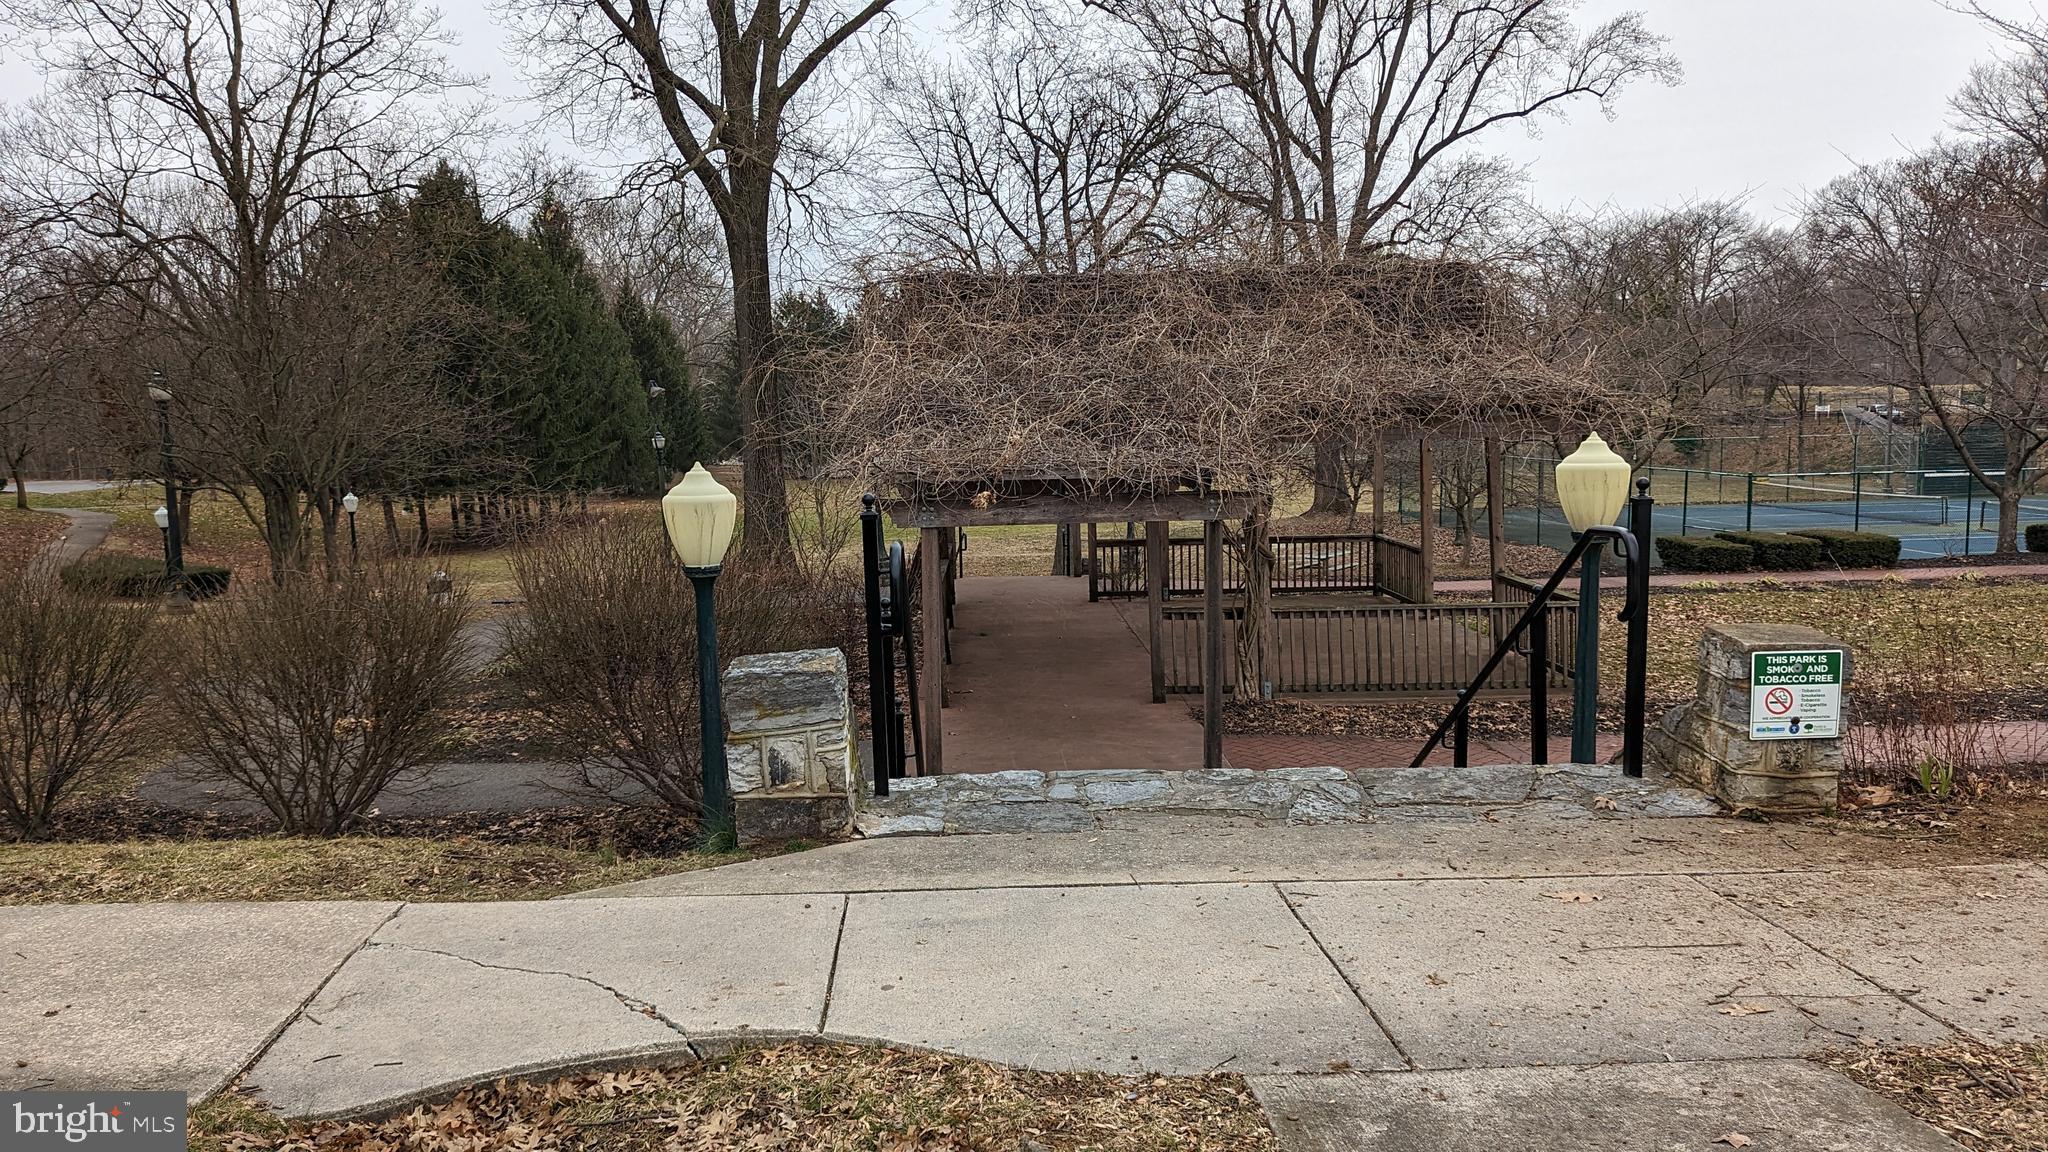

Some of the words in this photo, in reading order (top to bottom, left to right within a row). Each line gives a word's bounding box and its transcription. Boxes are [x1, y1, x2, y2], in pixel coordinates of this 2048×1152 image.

[1766, 656, 1788, 664] THIS
[1818, 655, 1827, 663] IS
[1806, 665, 1828, 673] AND
[1758, 675, 1807, 683] TOBACCO
[1809, 674, 1834, 682] FREE
